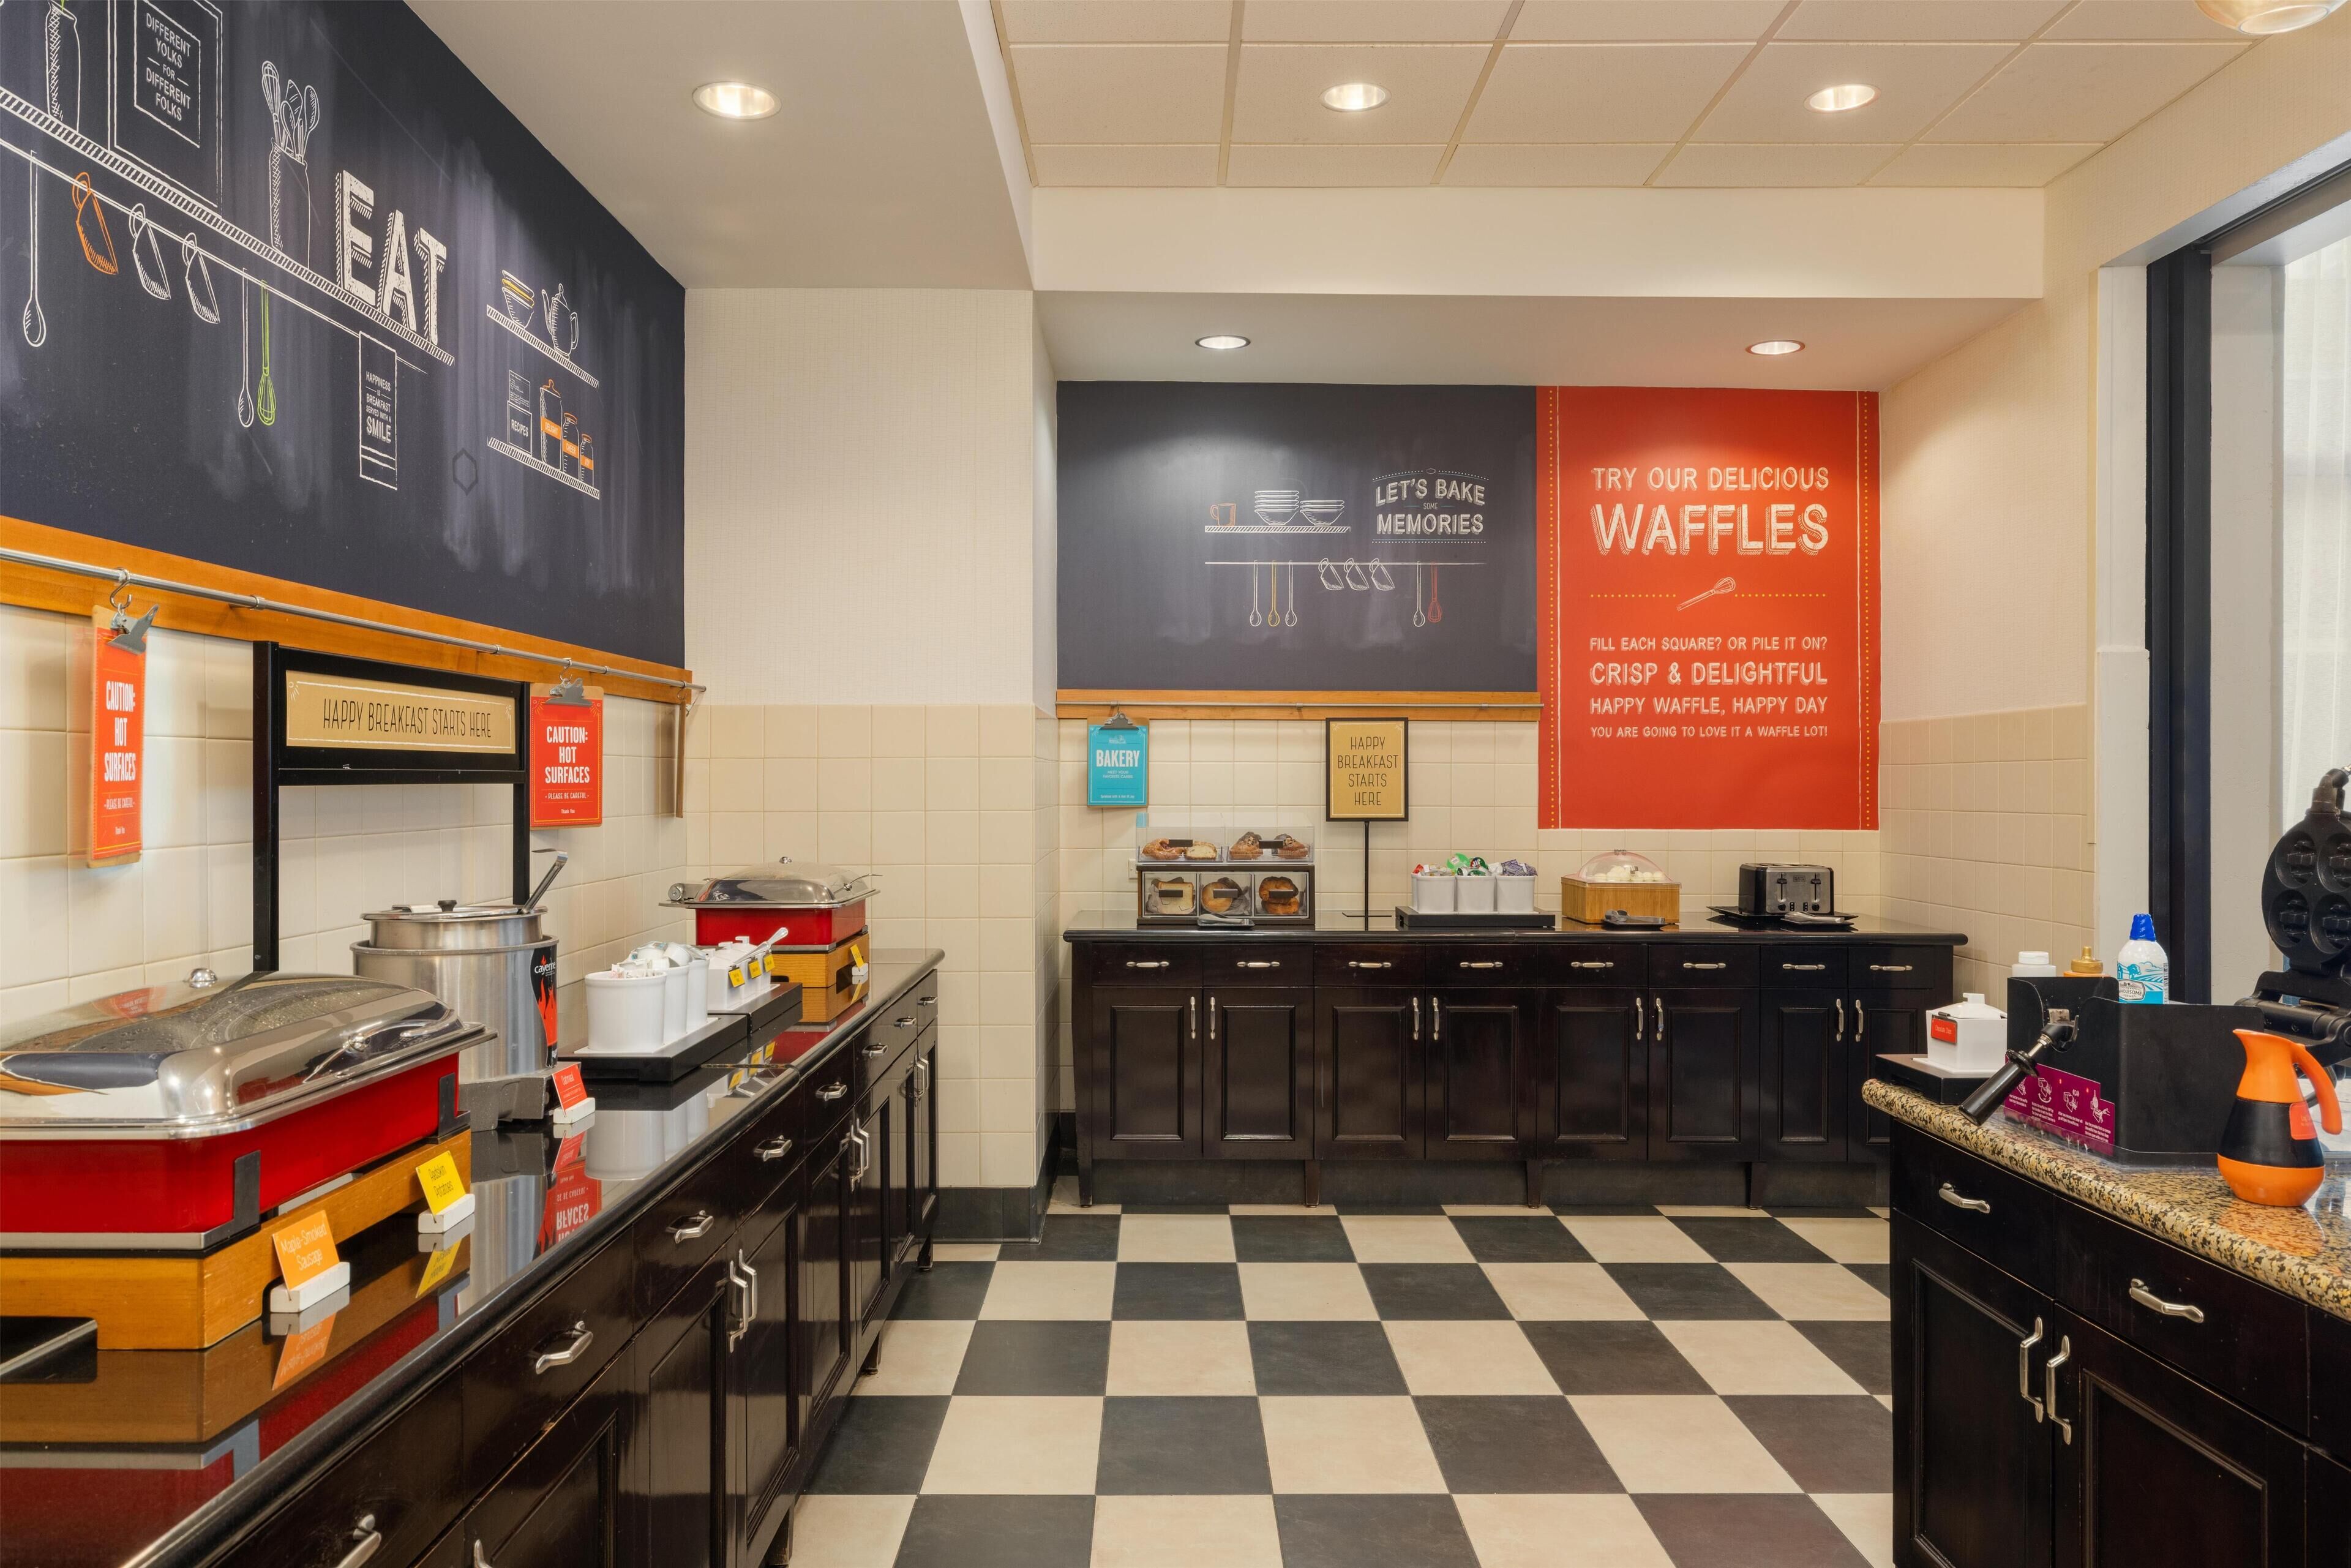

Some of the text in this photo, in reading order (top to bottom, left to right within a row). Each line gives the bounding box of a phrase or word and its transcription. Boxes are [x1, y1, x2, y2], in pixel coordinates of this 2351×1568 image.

[146, 13, 190, 57] DIFFERENT
[156, 38, 182, 69] YOLKS
[163, 64, 175, 81] FOR
[146, 67, 190, 109] DIFFERENT
[156, 92, 182, 121] FOLKS
[336, 170, 446, 344] EAT
[366, 371, 391, 392] HAPPINESS
[366, 393, 391, 413] BREAKFAST
[366, 405, 379, 417] SERVED
[380, 411, 389, 421] WITH
[366, 416, 392, 443] SMILE
[511, 419, 529, 437] RECIPES
[1591, 467, 1829, 491] TRY OUR DELICIOUS
[1376, 478, 1485, 507] LET'S BAKE
[1376, 514, 1484, 535] MEMORIES
[1590, 503, 1829, 556] WAFFLES
[1590, 636, 1828, 651] FILL EACH SQUARE? OR PILE IT ON?
[1590, 661, 1828, 685] CRISP & DELIGHTFUL
[106, 680, 136, 711] CAUTION:
[1590, 696, 1828, 716] HAPPY WAFFLE, HAPPY DAY
[323, 698, 491, 738] HAPPY BREAKFAST STARTS HERE
[114, 718, 127, 746] HOT
[546, 726, 588, 744] CAUTION:
[1590, 725, 1828, 738] YOU ARE GOING TO LOVE IT A WAFFLE LOT!
[1351, 736, 1385, 750] HAPPY
[558, 746, 577, 763] HOT
[1096, 749, 1140, 767] BAKERY
[1338, 754, 1398, 768] BREAKFAST
[104, 752, 136, 782] SURFACES
[545, 767, 590, 784] SURFACES
[1348, 773, 1387, 787] STARTS
[1354, 792, 1382, 806] HERE
[429, 1165, 447, 1182] Redskin
[433, 1180, 454, 1198] Potatoes
[280, 1223, 328, 1256] Maple-Smoked
[296, 1248, 323, 1271] Sausage
